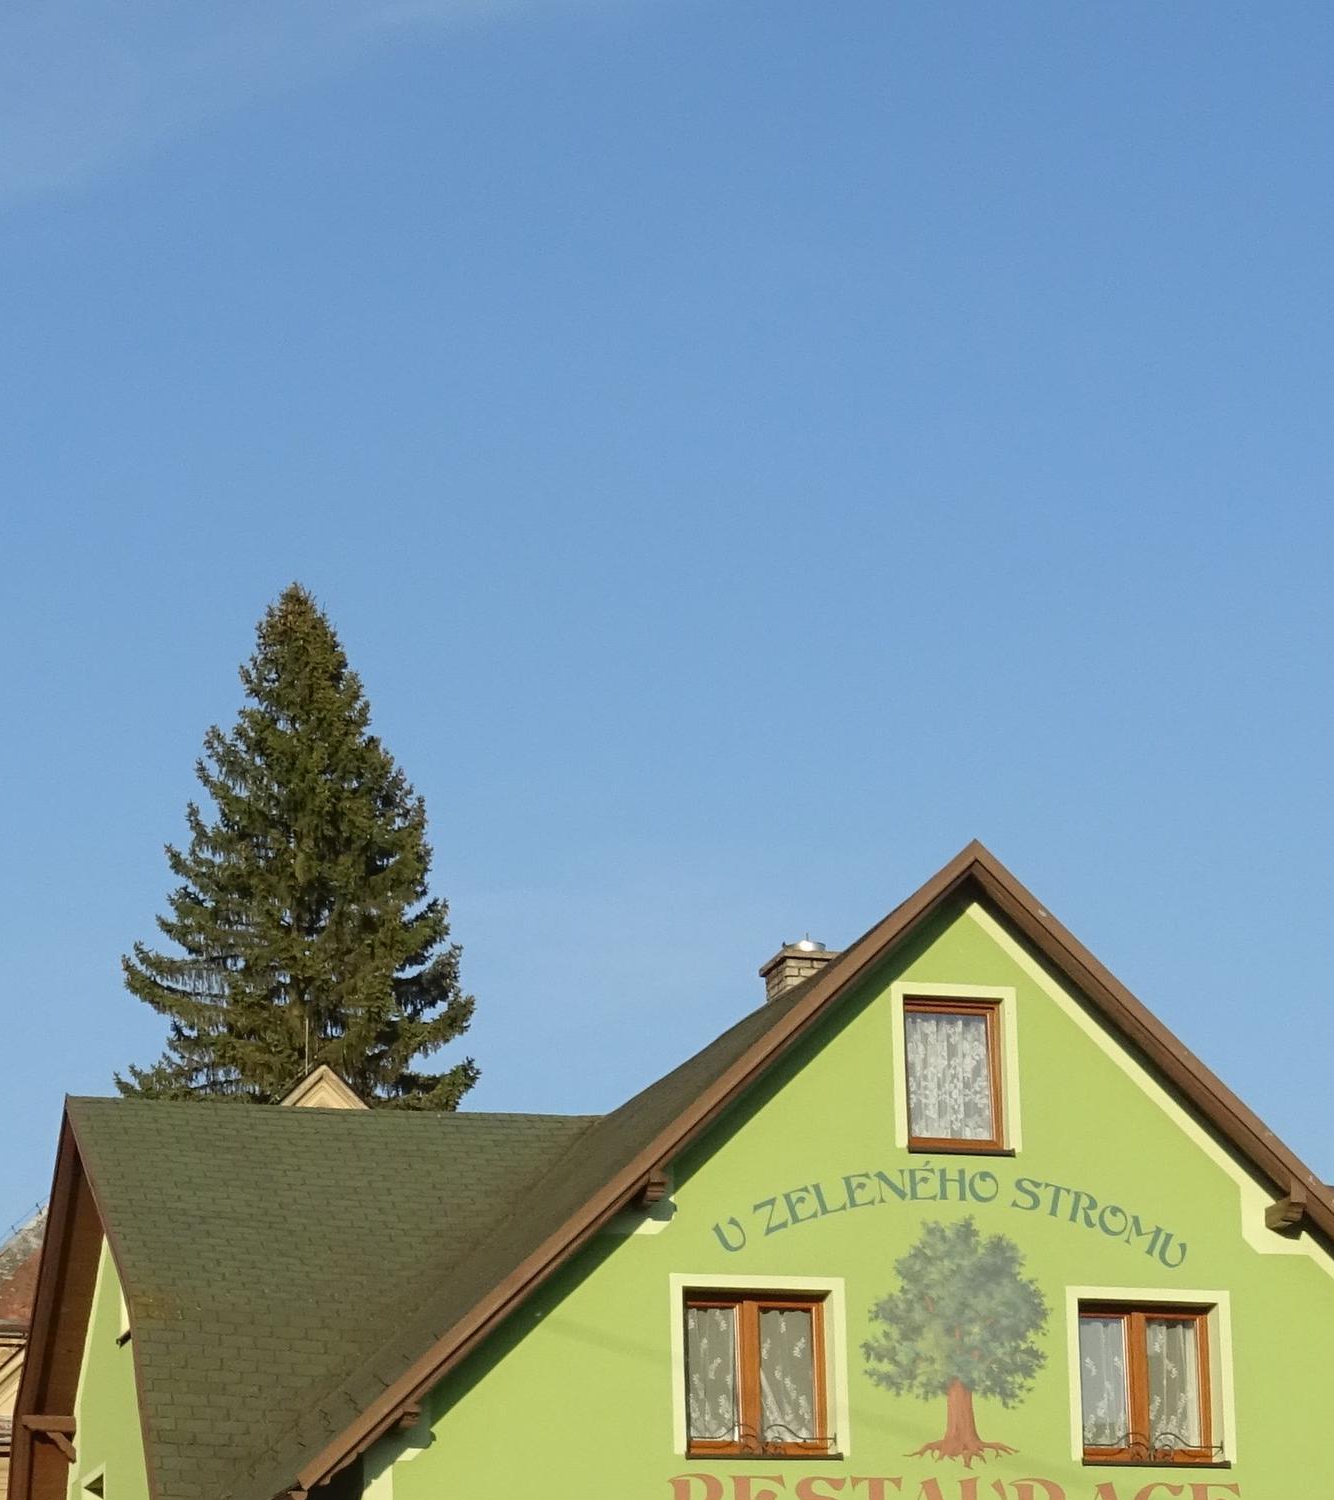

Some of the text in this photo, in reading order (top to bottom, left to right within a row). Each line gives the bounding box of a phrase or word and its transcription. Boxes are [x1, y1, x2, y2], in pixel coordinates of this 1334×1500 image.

[712, 1161, 1187, 1269] U ZELENÉHO STROMU
